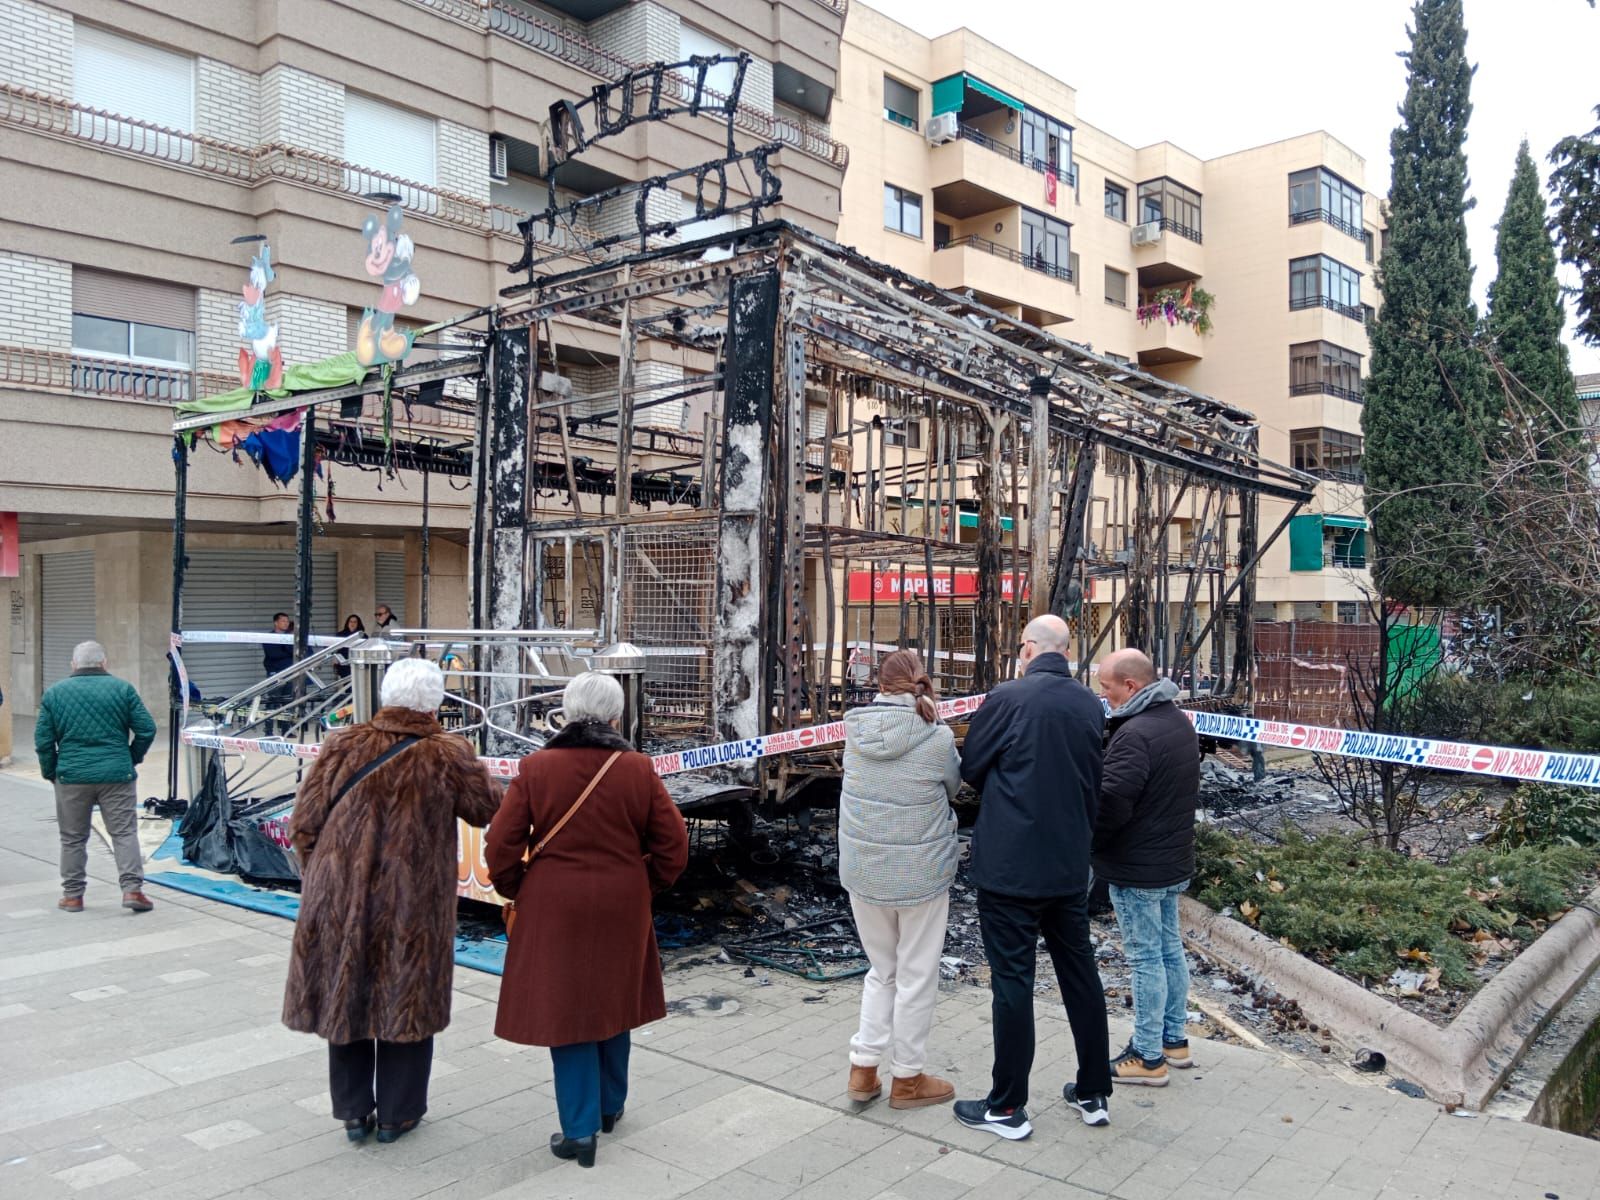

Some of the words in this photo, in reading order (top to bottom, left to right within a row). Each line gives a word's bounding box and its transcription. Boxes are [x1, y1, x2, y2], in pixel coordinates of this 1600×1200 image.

[815, 726, 826, 744] NO
[1195, 713, 1222, 737] POLICIA
[1221, 716, 1244, 738] LOCAL
[764, 739, 799, 754] SEGURIDAD
[767, 734, 786, 745] LINEA
[786, 732, 796, 742] DE
[1305, 728, 1319, 749] NO
[1319, 730, 1342, 751] PASAR
[1340, 732, 1377, 757] POLICIA
[1376, 737, 1408, 760] LOCAL
[682, 743, 718, 769] POLICIA
[718, 741, 747, 763] LOCAL
[1434, 742, 1457, 756] LINEA
[1457, 746, 1470, 758] DE
[655, 755, 681, 774] PASAR
[1425, 754, 1471, 769] SEGURIDAD
[1490, 750, 1509, 773] NO
[1509, 752, 1544, 778] PASAR
[1541, 755, 1593, 783] POLICIA
